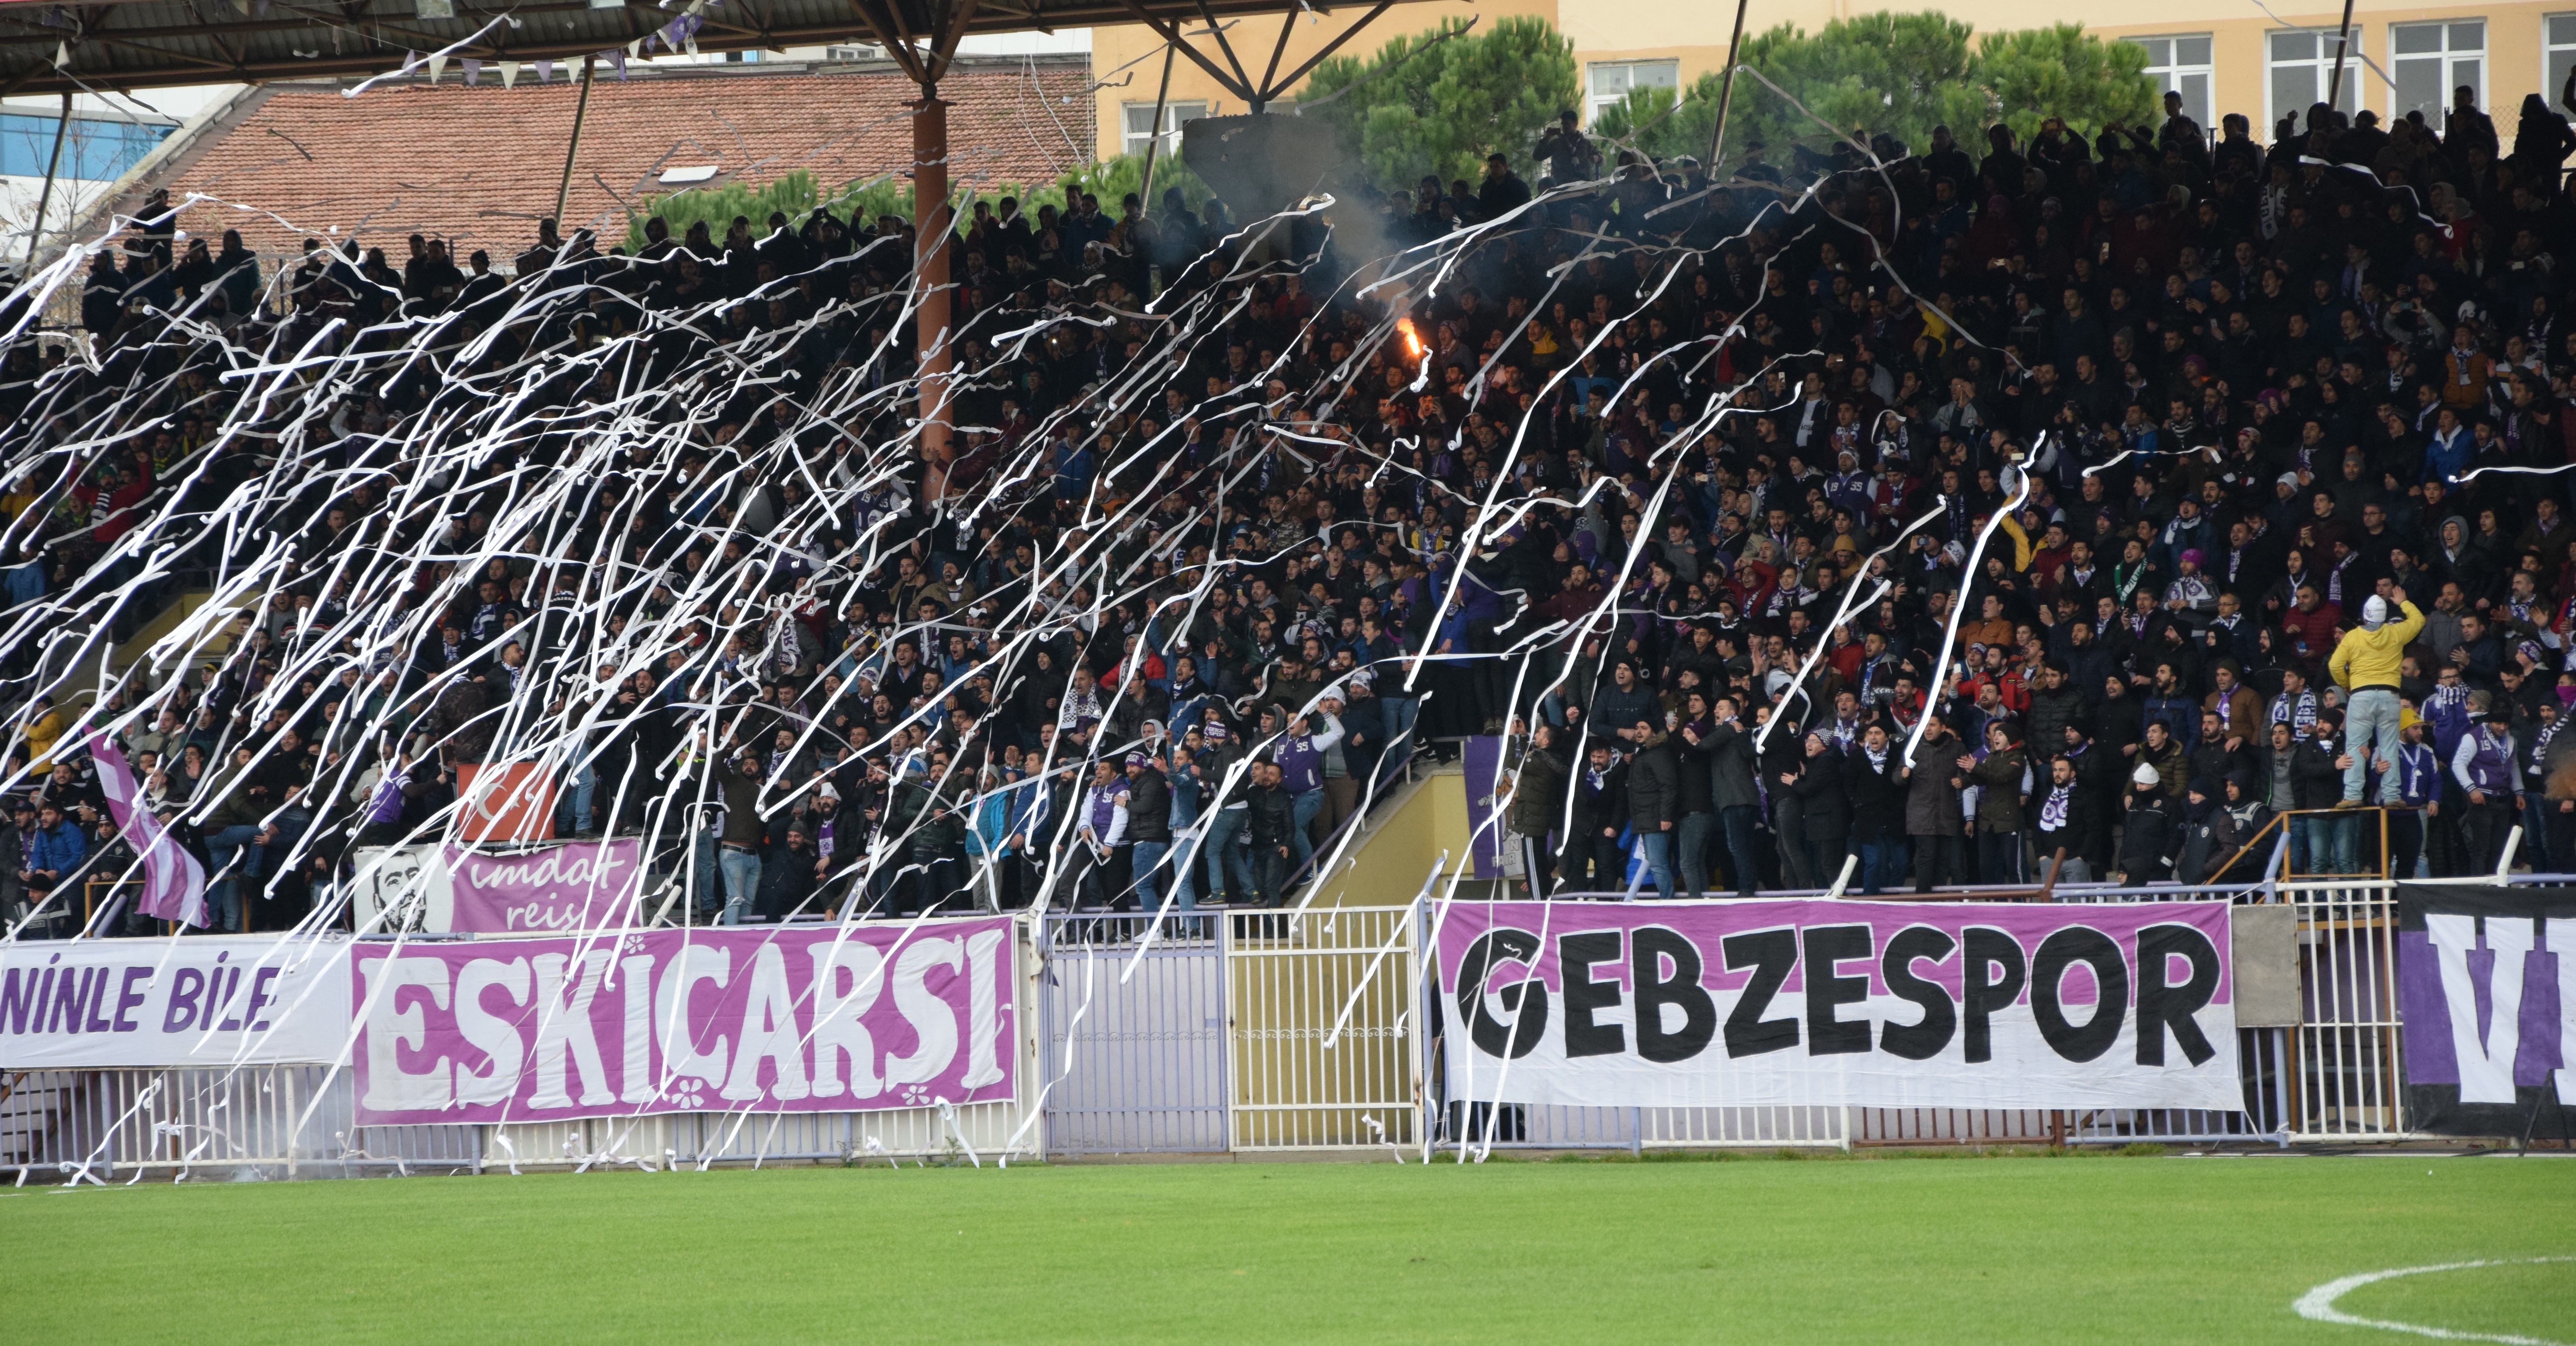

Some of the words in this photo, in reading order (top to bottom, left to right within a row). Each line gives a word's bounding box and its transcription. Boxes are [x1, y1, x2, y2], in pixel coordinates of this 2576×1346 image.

[1830, 482, 1839, 492] 19
[861, 492, 871, 503] 19
[1278, 745, 1285, 755] 19
[2480, 739, 2492, 751] 19
[506, 892, 586, 931] reis
[162, 950, 285, 1033] BİLE
[1457, 922, 2221, 1068] GEBZESPOR
